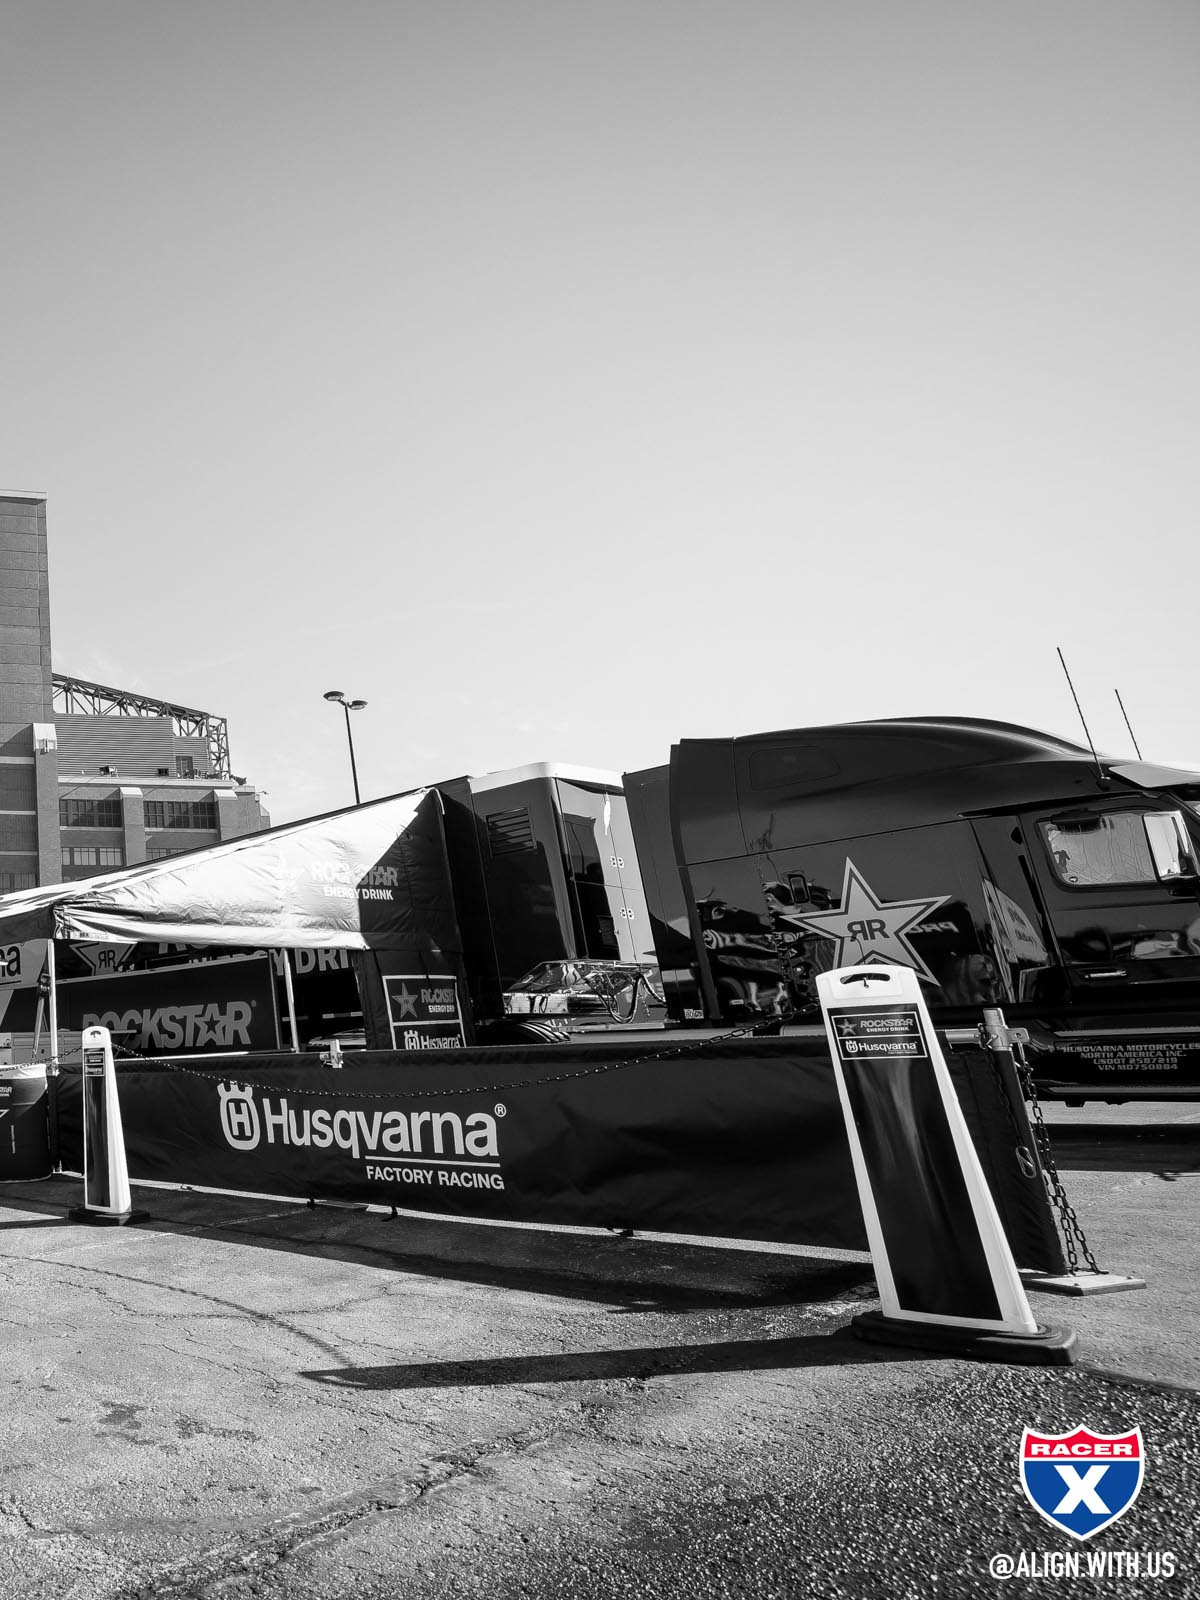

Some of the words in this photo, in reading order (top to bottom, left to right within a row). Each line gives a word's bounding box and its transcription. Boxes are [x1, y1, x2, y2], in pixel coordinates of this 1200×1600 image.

[324, 886, 360, 900] ENERGY
[362, 888, 394, 901] DRINK
[860, 1018, 913, 1028] ROCKSTAR
[859, 1042, 917, 1052] Husqvarna
[1126, 1043, 1200, 1051] MOTORCYCLES
[366, 1165, 436, 1185] FACTORY
[438, 1171, 505, 1190] RACING
